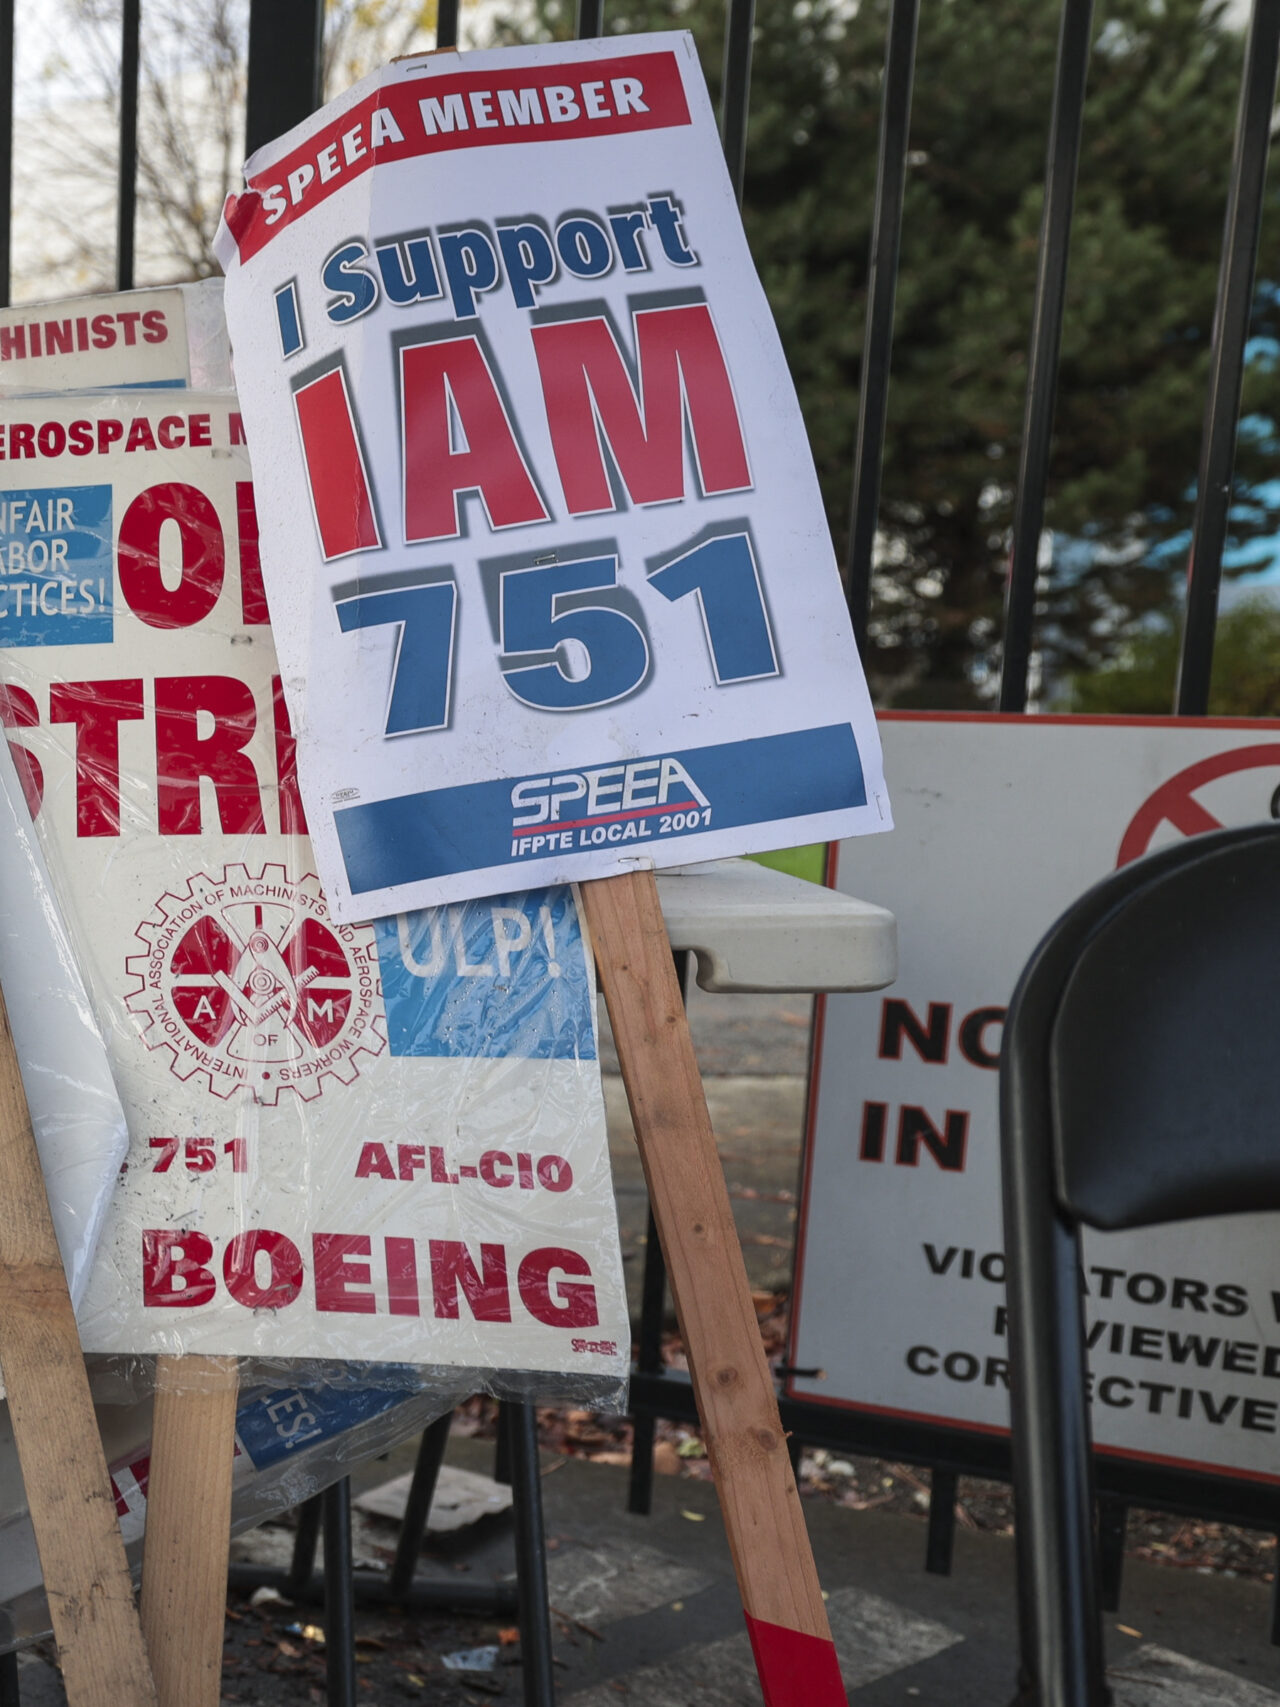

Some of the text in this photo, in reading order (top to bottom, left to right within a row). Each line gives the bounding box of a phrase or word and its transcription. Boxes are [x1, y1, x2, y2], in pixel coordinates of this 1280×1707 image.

[263, 77, 650, 226] SPEEA MEMBER
[274, 194, 699, 359] I Support
[292, 302, 755, 563] IAM
[334, 531, 781, 740] 751
[511, 757, 711, 827] SPEEA
[511, 807, 712, 857] IFPTE LOCAL 2001
[204, 889, 225, 905] OF
[149, 901, 203, 989] ASSOCIATION
[396, 904, 561, 978] ULP!
[349, 946, 372, 1039] AEROSPACE
[156, 993, 247, 1079] INTERNATIONAL
[280, 1039, 354, 1081] WORKERS
[149, 1137, 574, 1193] 751 AFL-CIO
[859, 1100, 971, 1173] IN
[142, 1228, 600, 1329] BOEING
